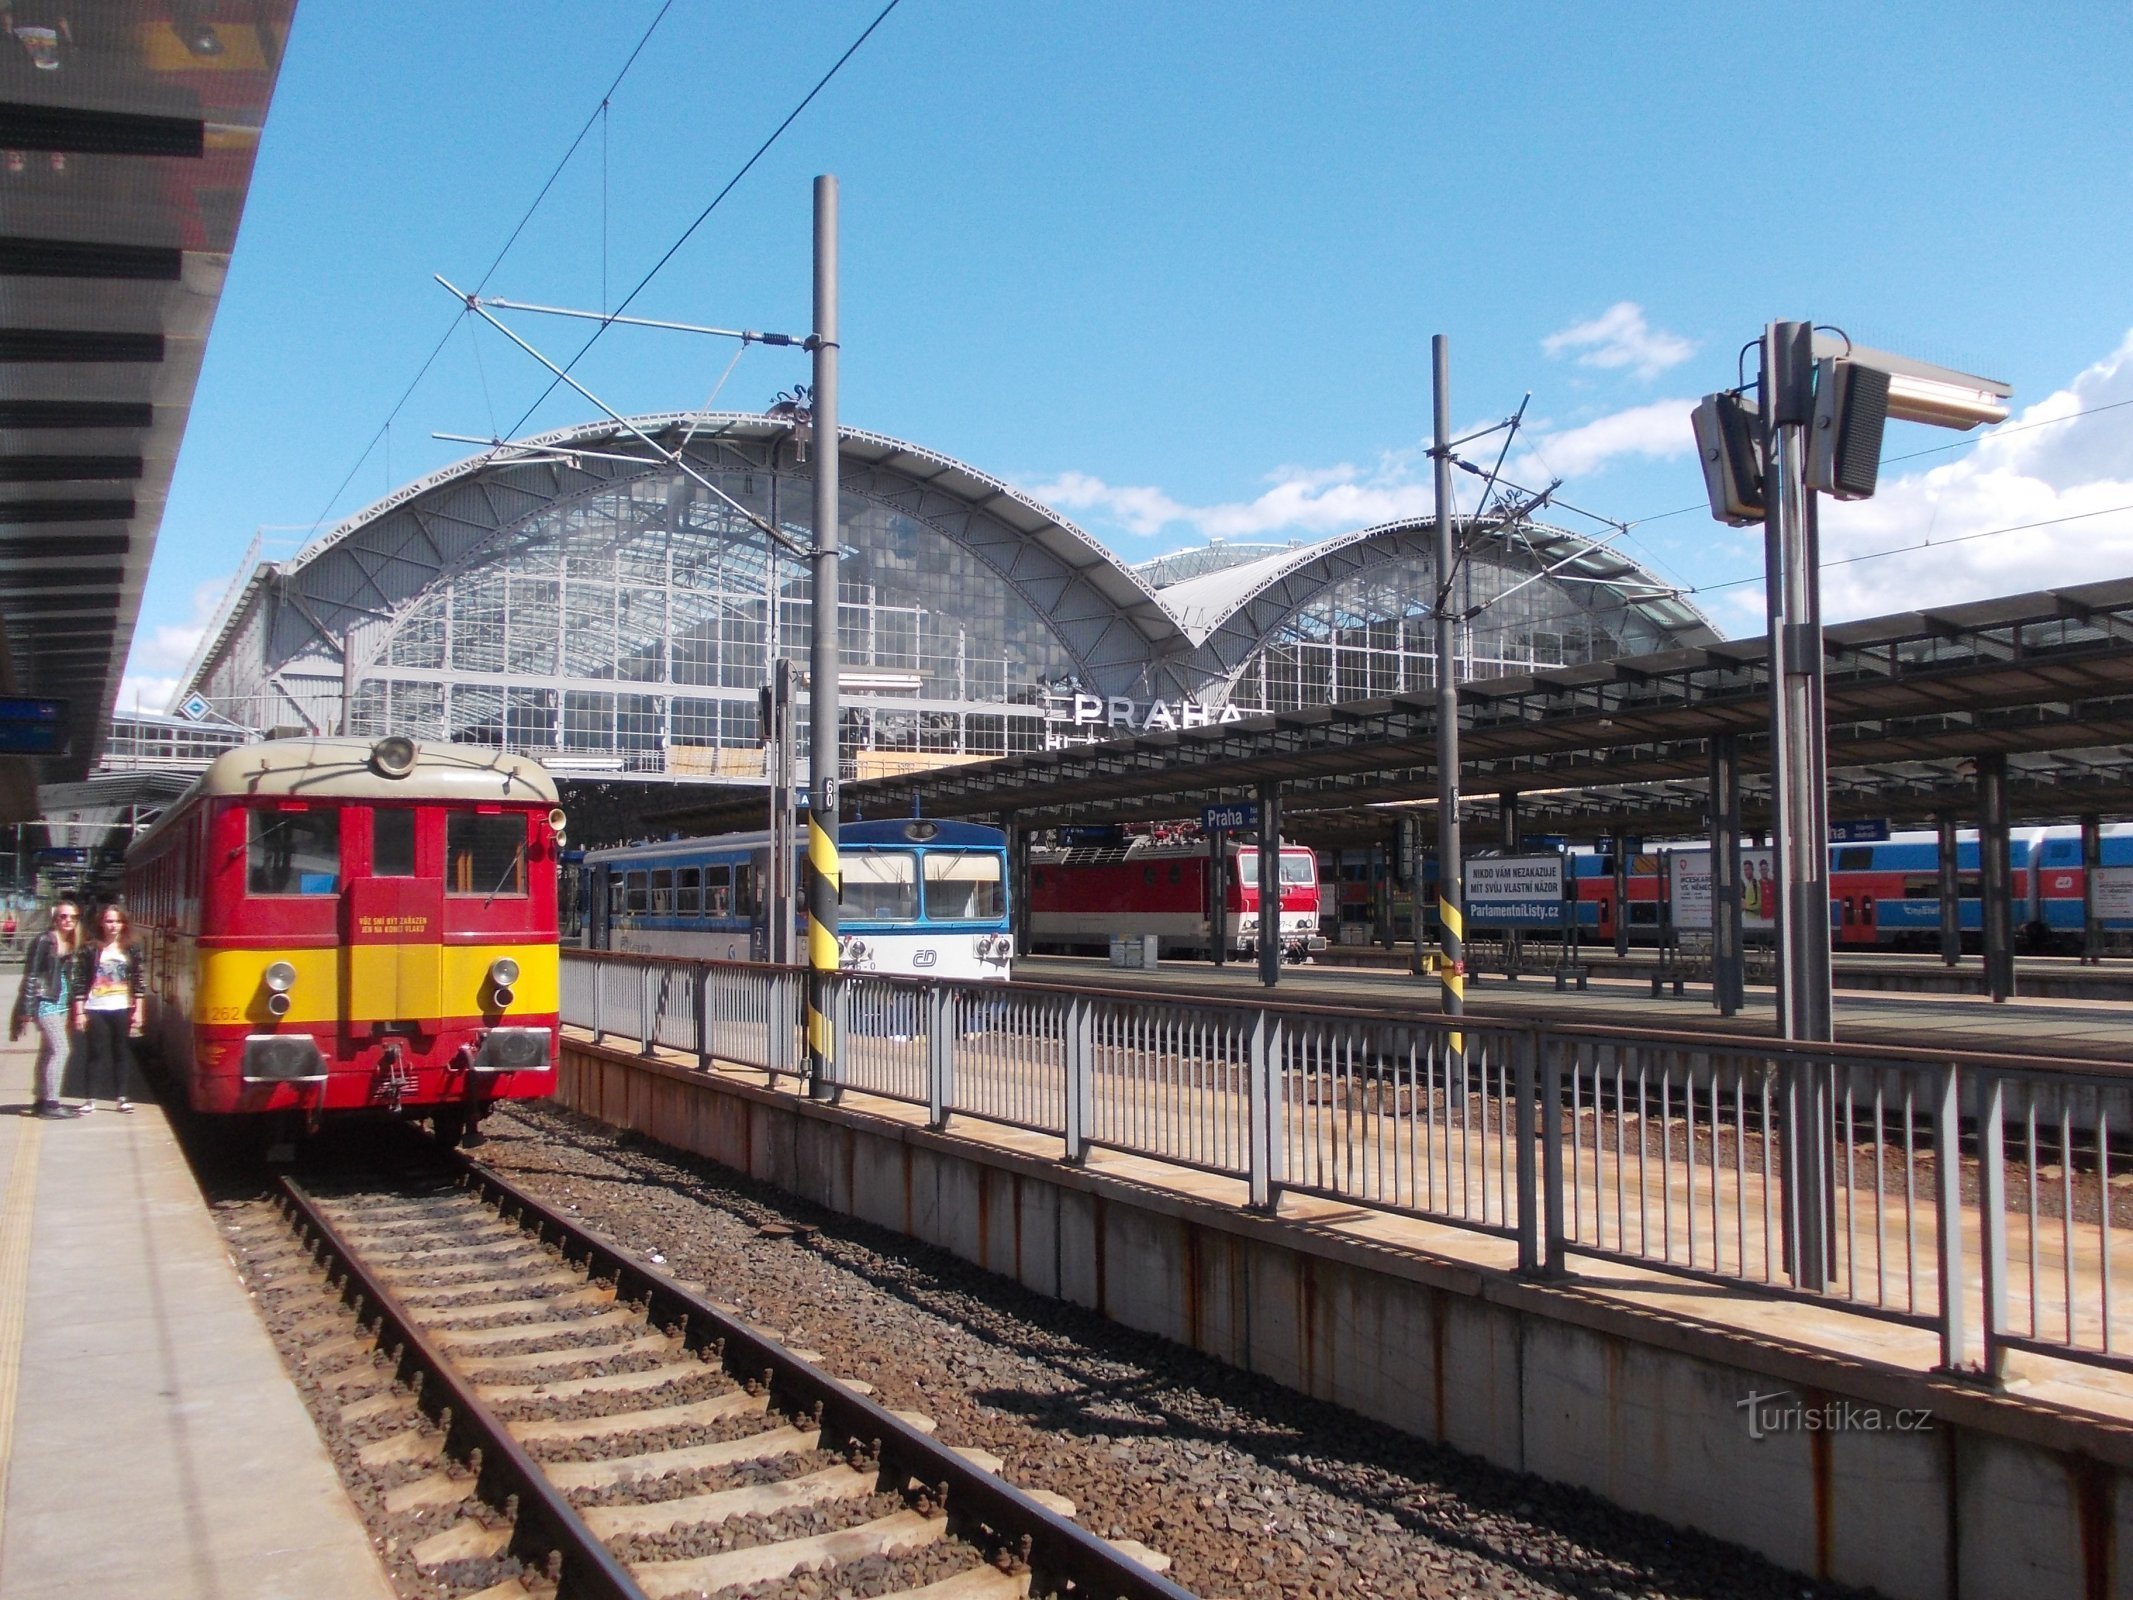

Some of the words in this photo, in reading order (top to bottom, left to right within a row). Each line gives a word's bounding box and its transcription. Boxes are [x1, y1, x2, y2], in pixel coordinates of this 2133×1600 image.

[1074, 693, 1243, 730] PRAHA
[1207, 808, 1243, 827] Praha
[1473, 868, 1494, 878] NIKDO
[1496, 865, 1511, 878] VÁM
[1513, 866, 1557, 877] NEZAKAZUJE
[1470, 881, 1483, 893] MÍT
[1485, 881, 1502, 893] SVŮJ
[1504, 880, 1533, 892] VLASTNÍ
[1534, 879, 1558, 892] NÁZOR
